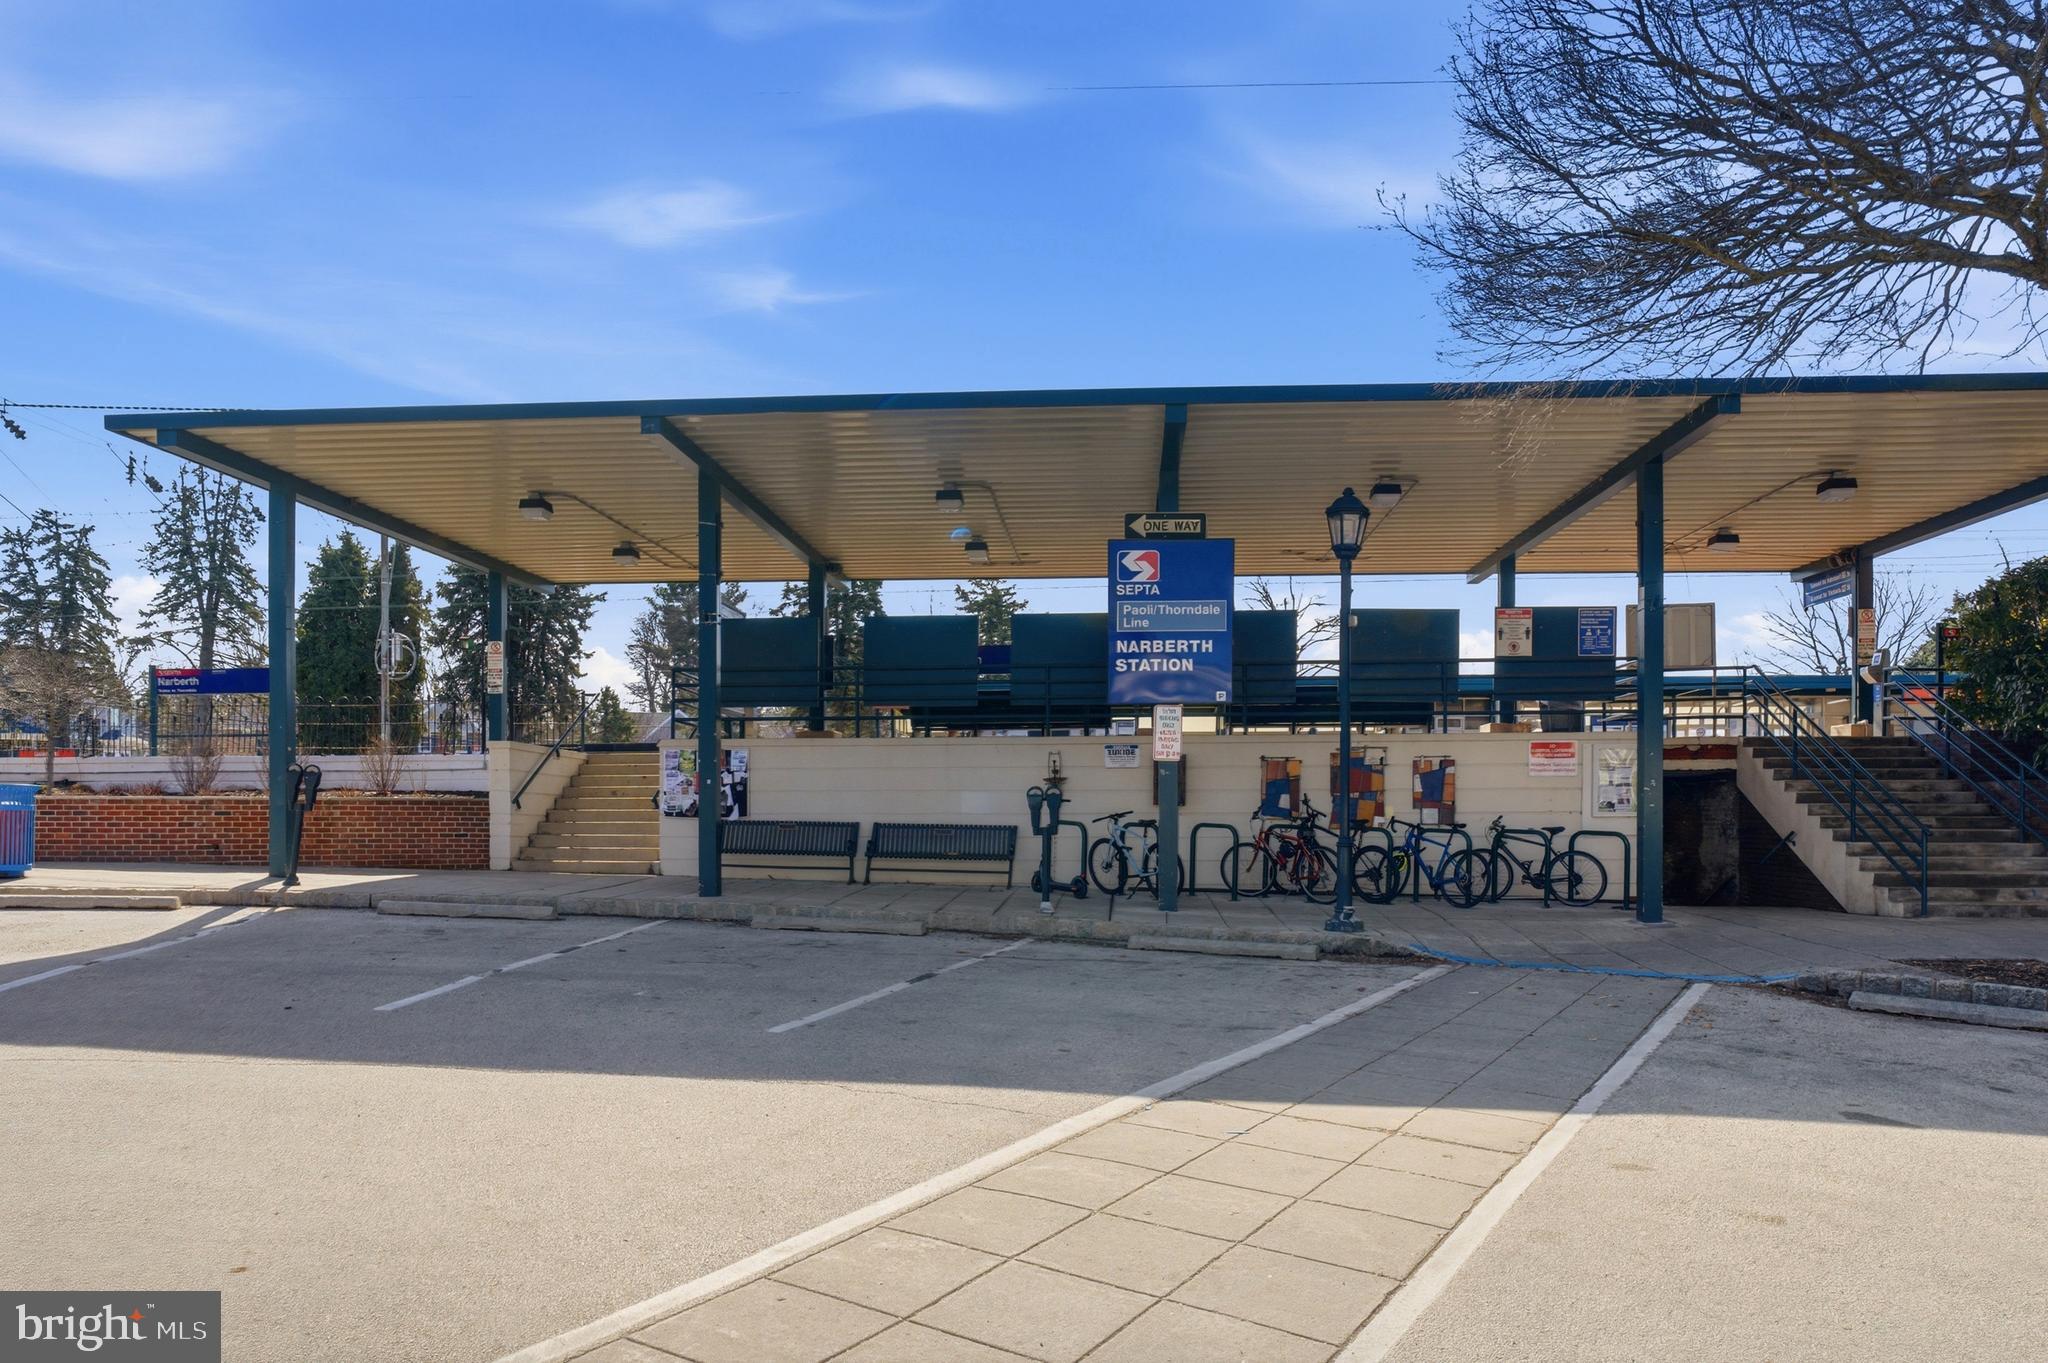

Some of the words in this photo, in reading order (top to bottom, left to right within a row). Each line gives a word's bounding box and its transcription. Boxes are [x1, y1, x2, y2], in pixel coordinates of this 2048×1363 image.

[1143, 521, 1169, 532] ONE
[1174, 521, 1200, 532] WAY
[1116, 584, 1160, 596] SEPTA
[1123, 604, 1221, 615] Paoli/Thorndale
[1123, 617, 1150, 628] Line
[1116, 640, 1213, 653] NARBERTH
[1115, 659, 1194, 672] STATION
